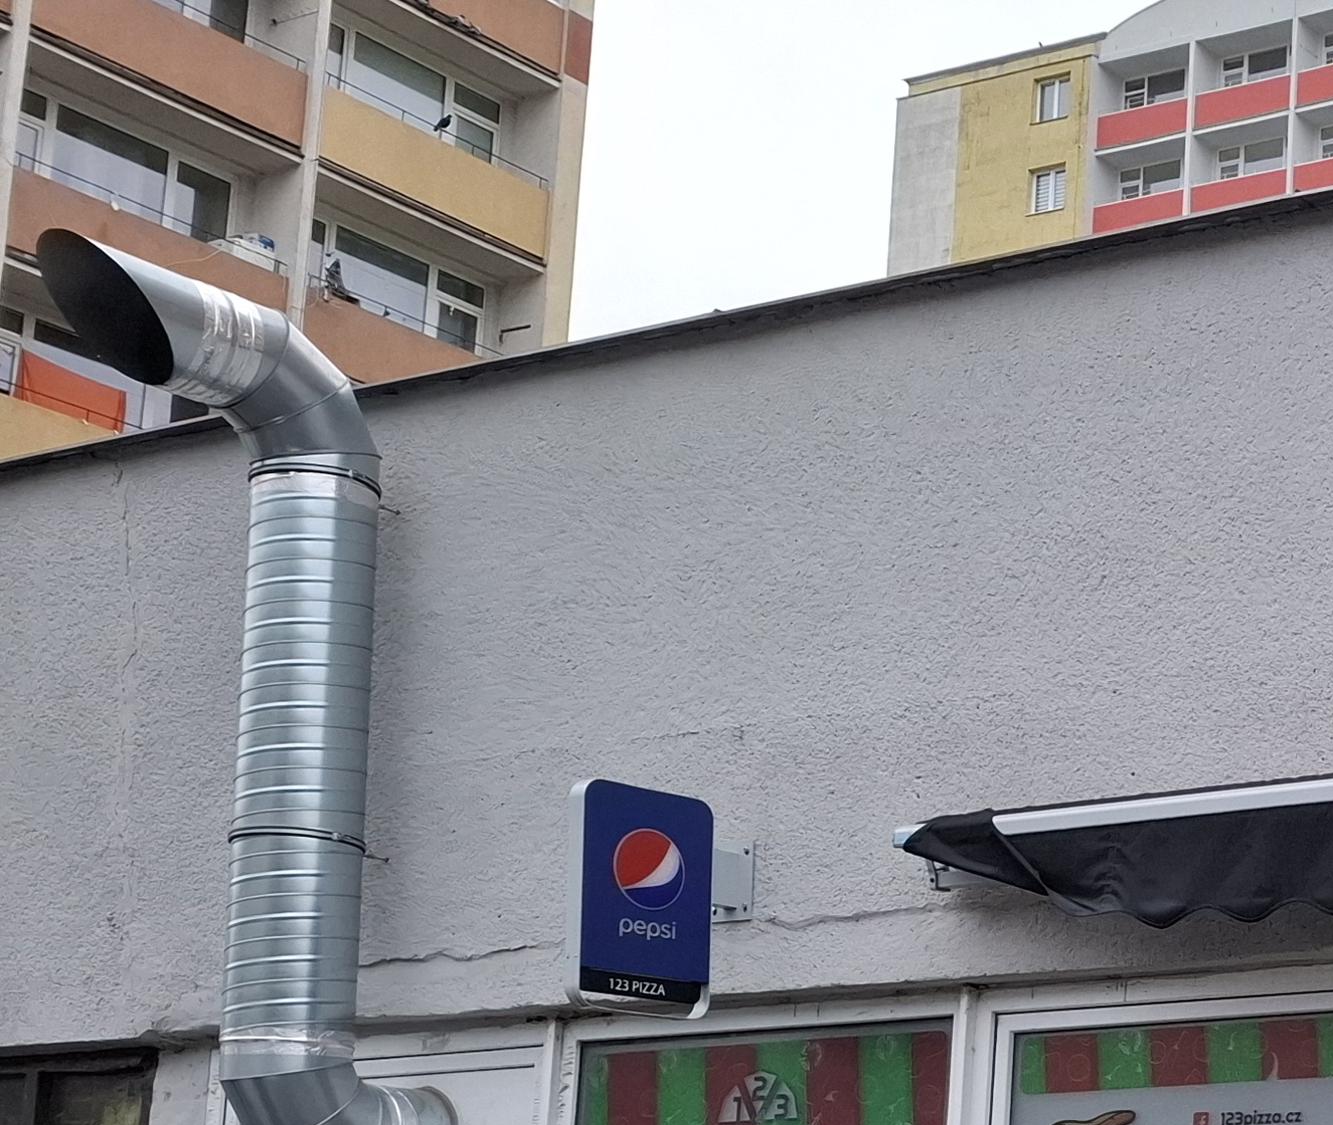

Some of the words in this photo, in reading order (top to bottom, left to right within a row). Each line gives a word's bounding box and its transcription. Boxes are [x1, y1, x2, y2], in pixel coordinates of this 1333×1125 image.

[618, 918, 677, 940] pepsi
[608, 978, 629, 993] 123
[632, 981, 666, 996] PIZZA
